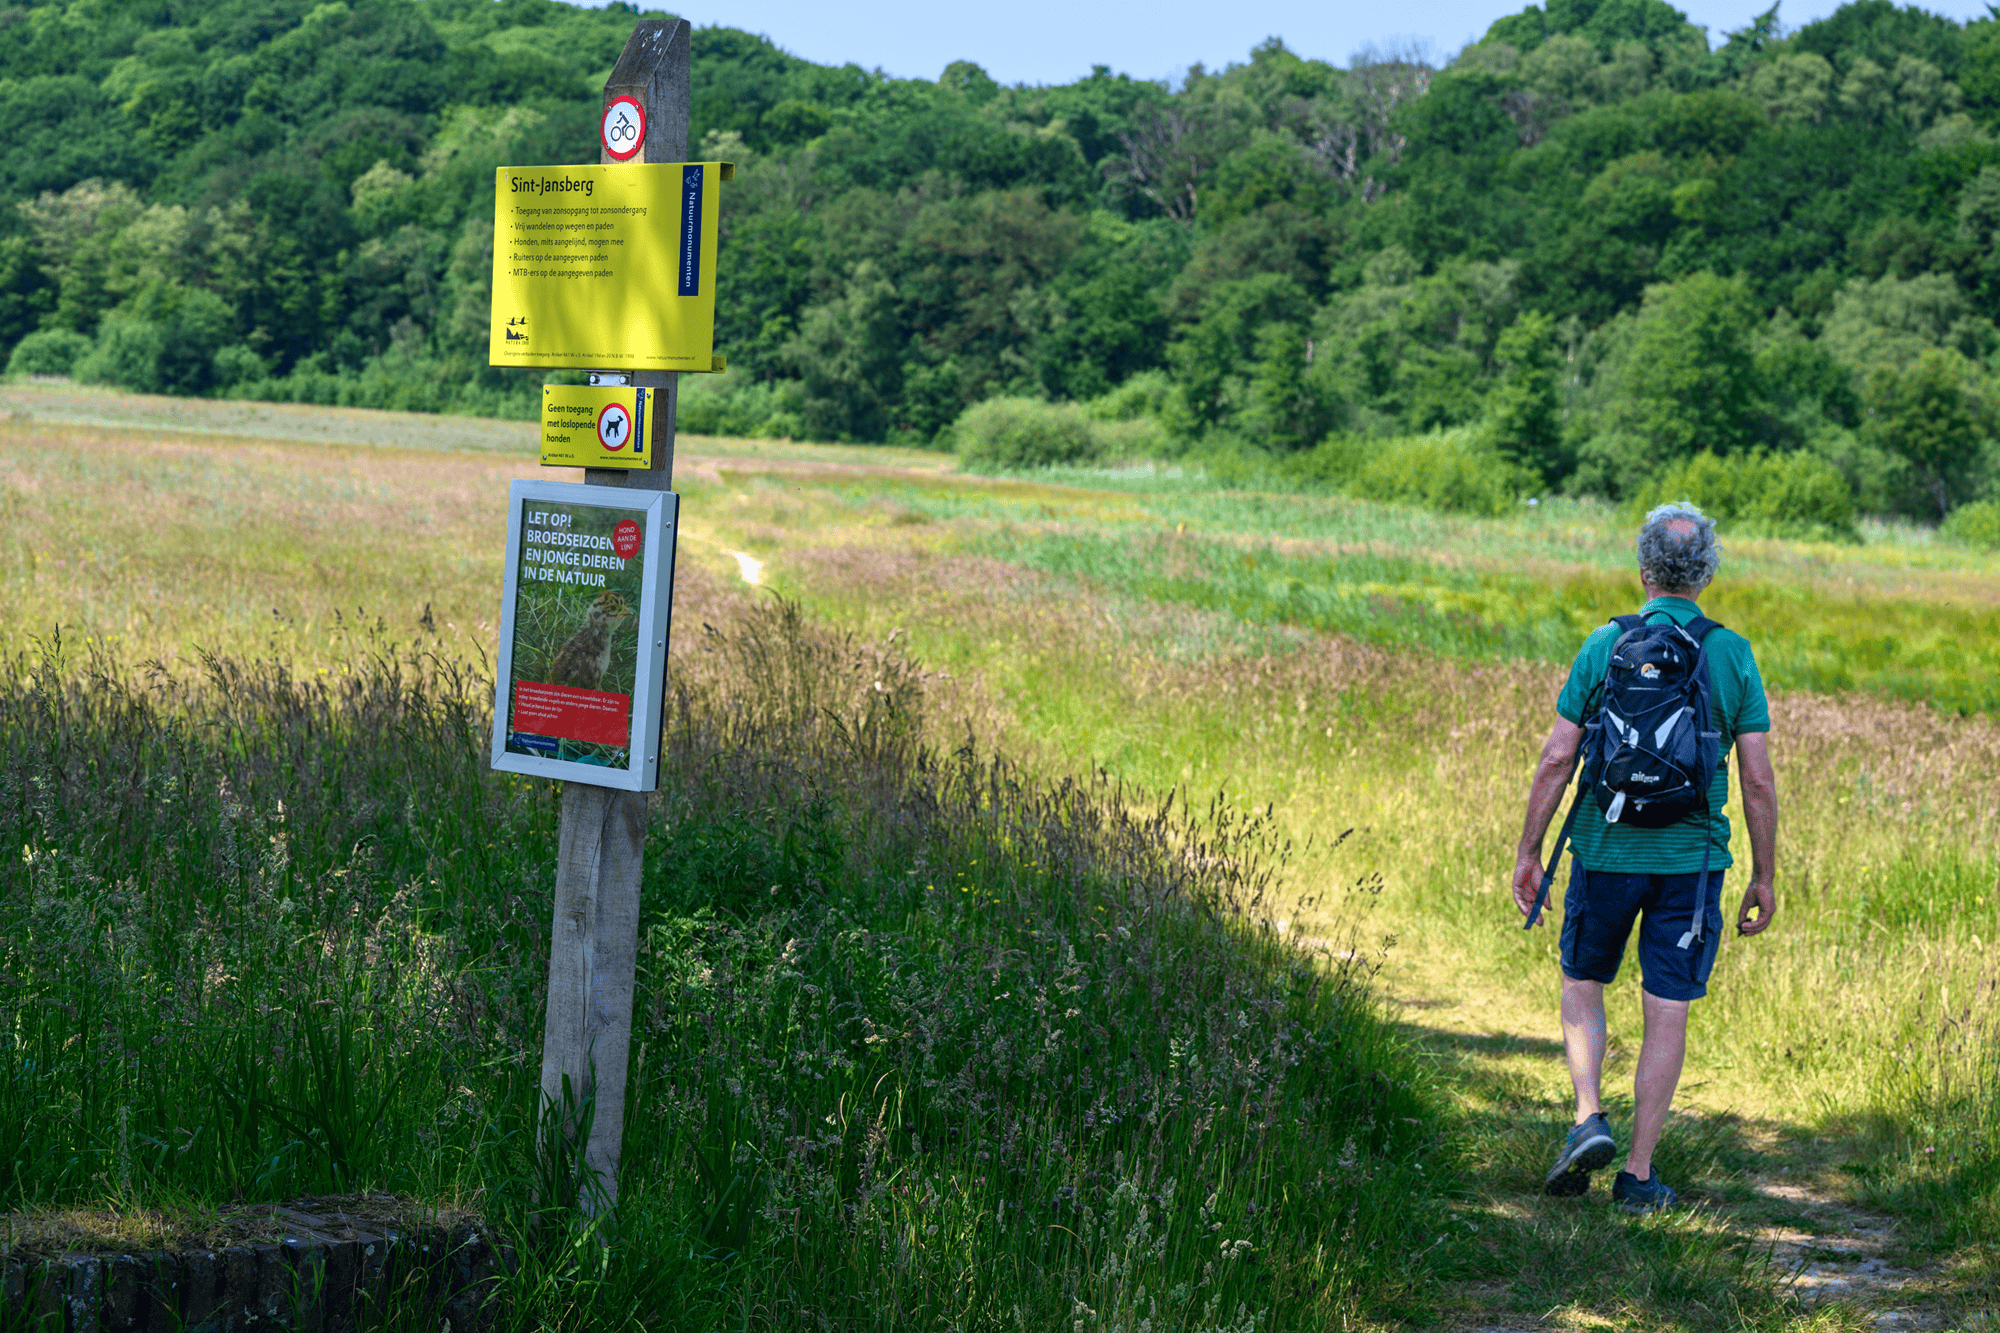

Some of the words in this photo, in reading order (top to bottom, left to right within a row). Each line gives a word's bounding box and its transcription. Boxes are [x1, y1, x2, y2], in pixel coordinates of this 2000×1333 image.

[511, 176, 594, 196] Sint-Jansberg
[515, 206, 540, 217] Toegang
[553, 207, 589, 217] zonsopgang
[590, 206, 599, 214] tot
[600, 205, 647, 216] zonsondergang
[515, 222, 525, 232] Vrij
[526, 222, 555, 230] wandelen
[556, 224, 564, 232] op
[565, 223, 586, 232] wegen
[595, 222, 614, 232] paden
[514, 237, 539, 247] Honden,
[541, 238, 553, 246] mits
[554, 237, 587, 248] aangelijnd,
[588, 239, 609, 248] mogen
[686, 192, 696, 288] Natuurmonumenten
[513, 253, 534, 261] Ruiters
[535, 255, 543, 263] op
[544, 253, 552, 261] de
[553, 254, 589, 263] aangegeven
[590, 253, 608, 263] paden
[513, 268, 539, 276] MTB-ers
[540, 270, 548, 278] op
[549, 268, 557, 277] de
[558, 270, 593, 279] aangegeven
[594, 268, 613, 278] paden
[548, 403, 565, 412] Geen
[566, 405, 593, 416] toegang
[547, 419, 560, 428] met
[561, 419, 596, 431] loslopende
[546, 433, 570, 443] honden
[528, 511, 549, 525] LET
[550, 513, 572, 527] OP!
[527, 530, 615, 550] BROEDSEIZOEN
[526, 548, 540, 561] EN
[542, 550, 580, 566] JONGE
[582, 554, 625, 570] DIEREN
[524, 566, 536, 580] IN
[539, 568, 554, 581] DE
[556, 570, 605, 587] NATUUR
